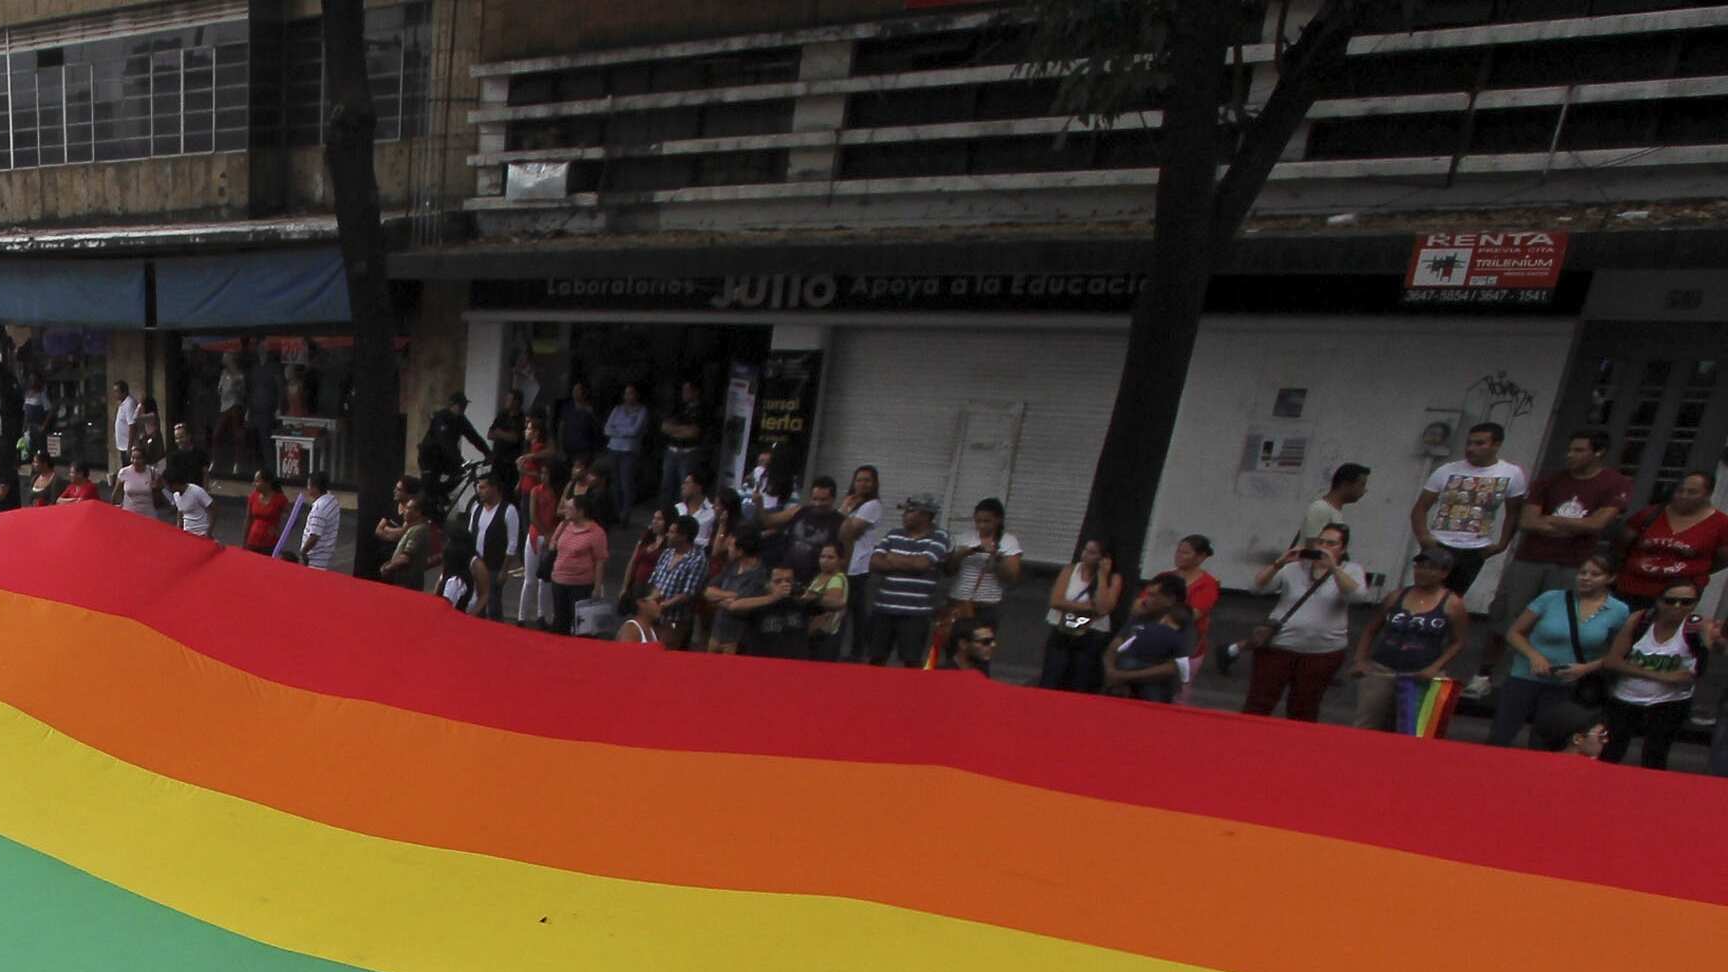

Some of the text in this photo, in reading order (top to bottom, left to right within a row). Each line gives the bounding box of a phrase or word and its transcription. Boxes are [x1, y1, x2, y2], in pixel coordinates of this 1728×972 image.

[1425, 230, 1554, 247] RENTA
[1527, 245, 1554, 254] CITA
[548, 272, 695, 297] Laboratorios
[849, 274, 938, 300] Apoya
[951, 279, 968, 297] a
[975, 273, 1002, 297] la
